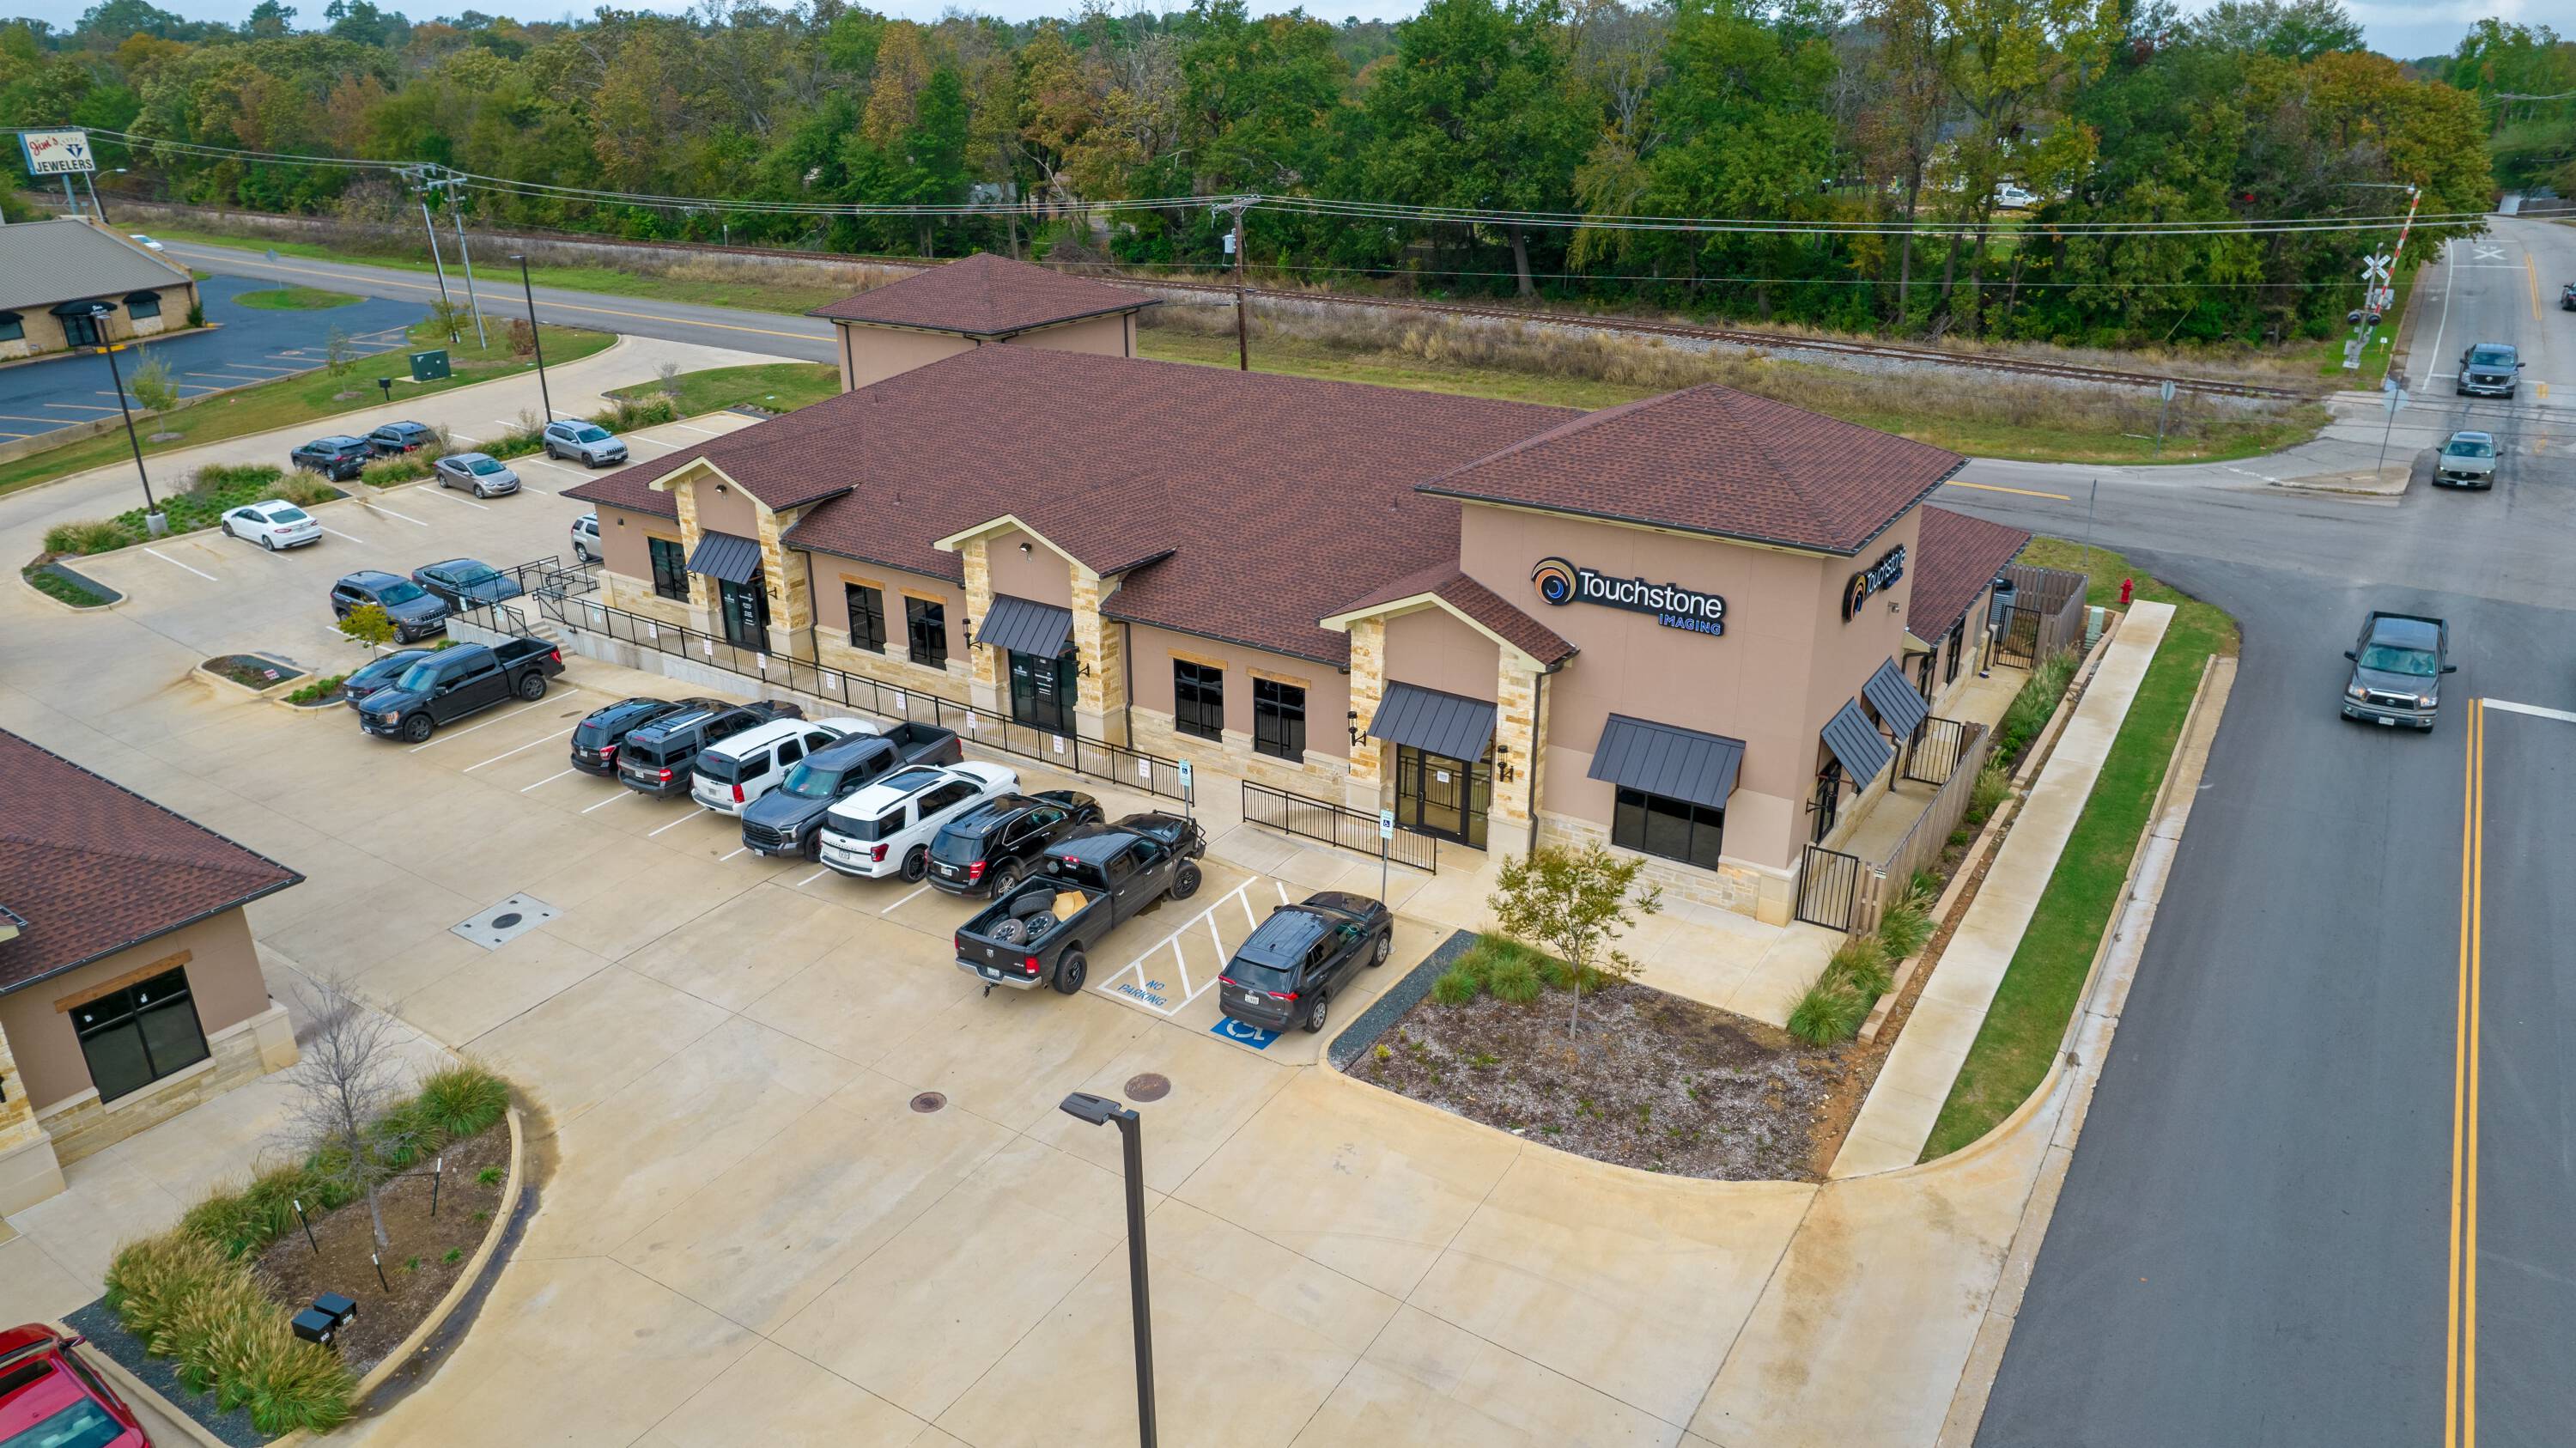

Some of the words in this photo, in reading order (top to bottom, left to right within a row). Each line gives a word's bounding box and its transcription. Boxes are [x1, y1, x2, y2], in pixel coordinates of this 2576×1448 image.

[36, 159, 93, 173] JEWELERS
[1579, 571, 1722, 618] Touchstone
[1658, 613, 1722, 636] IMAGING
[1117, 983, 1168, 1007] PARKING
[1145, 979, 1165, 991] NO
